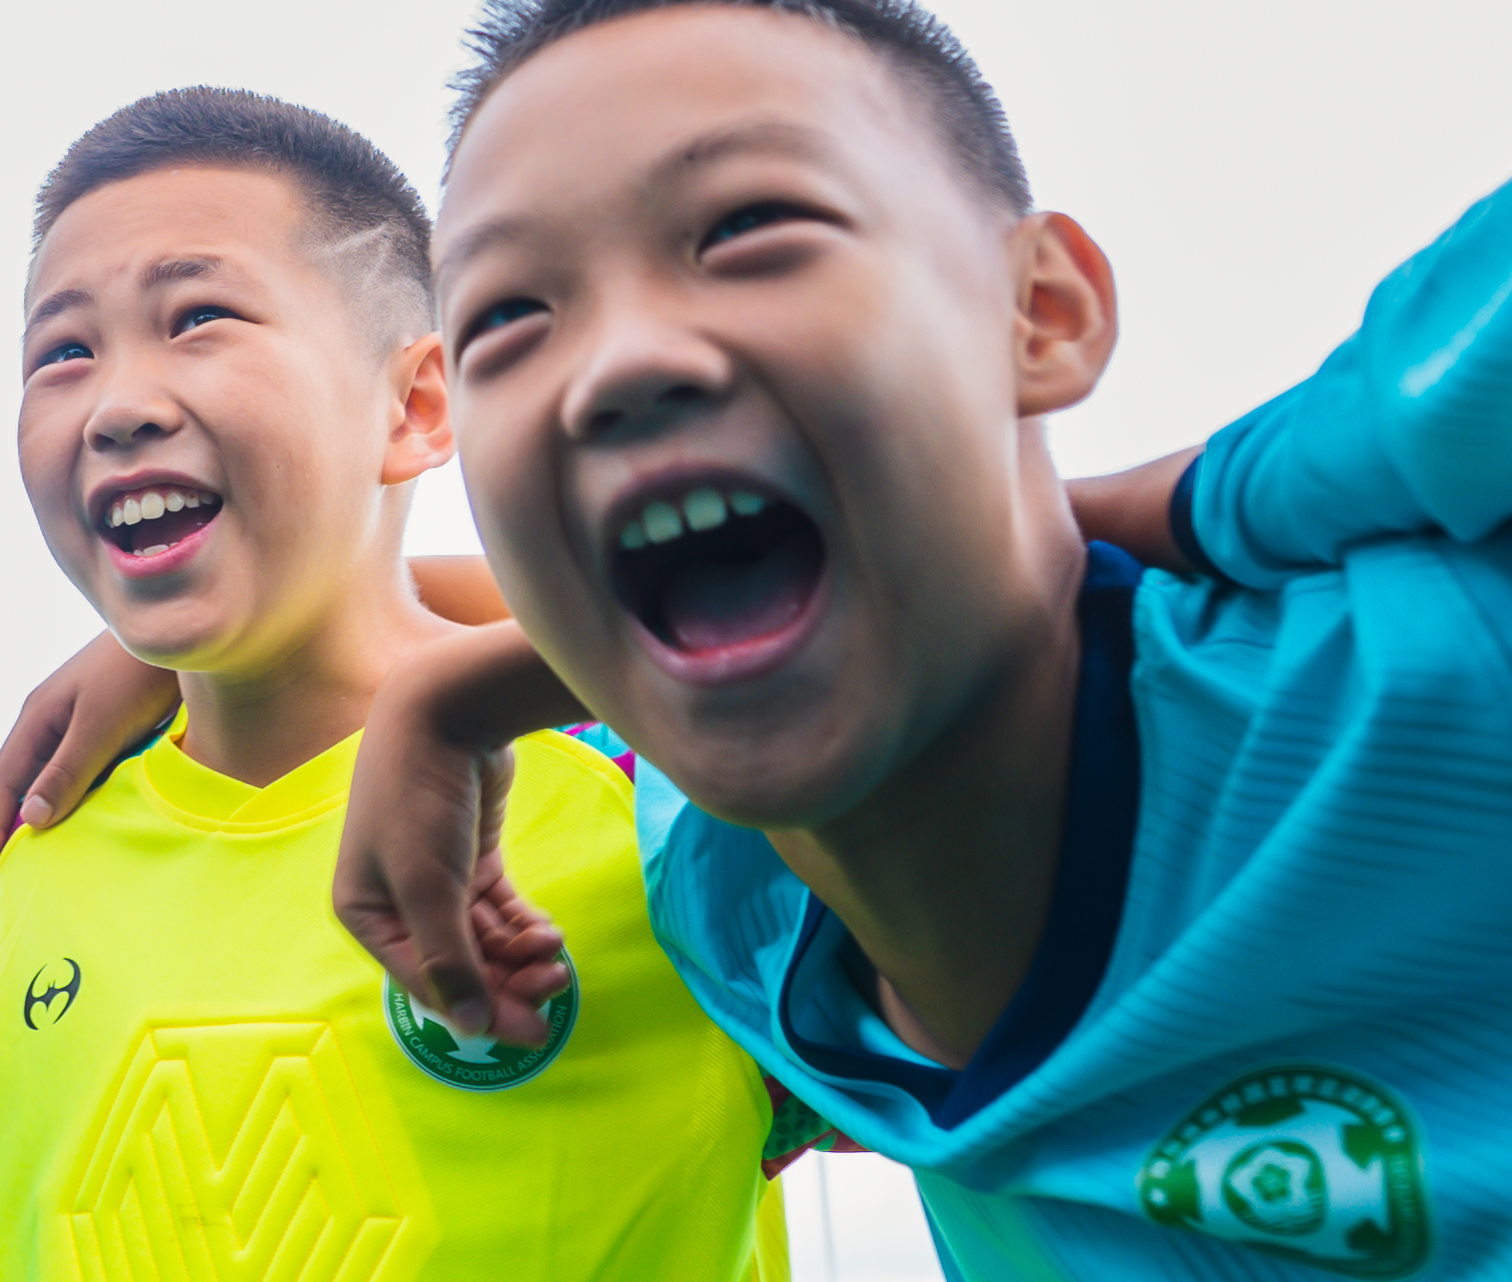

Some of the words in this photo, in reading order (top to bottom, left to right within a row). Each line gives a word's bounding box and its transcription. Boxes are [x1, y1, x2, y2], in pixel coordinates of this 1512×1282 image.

[393, 992, 414, 1037] HARBIN
[409, 1035, 454, 1075] CAMPUS
[454, 1065, 517, 1082] FOOTBALL
